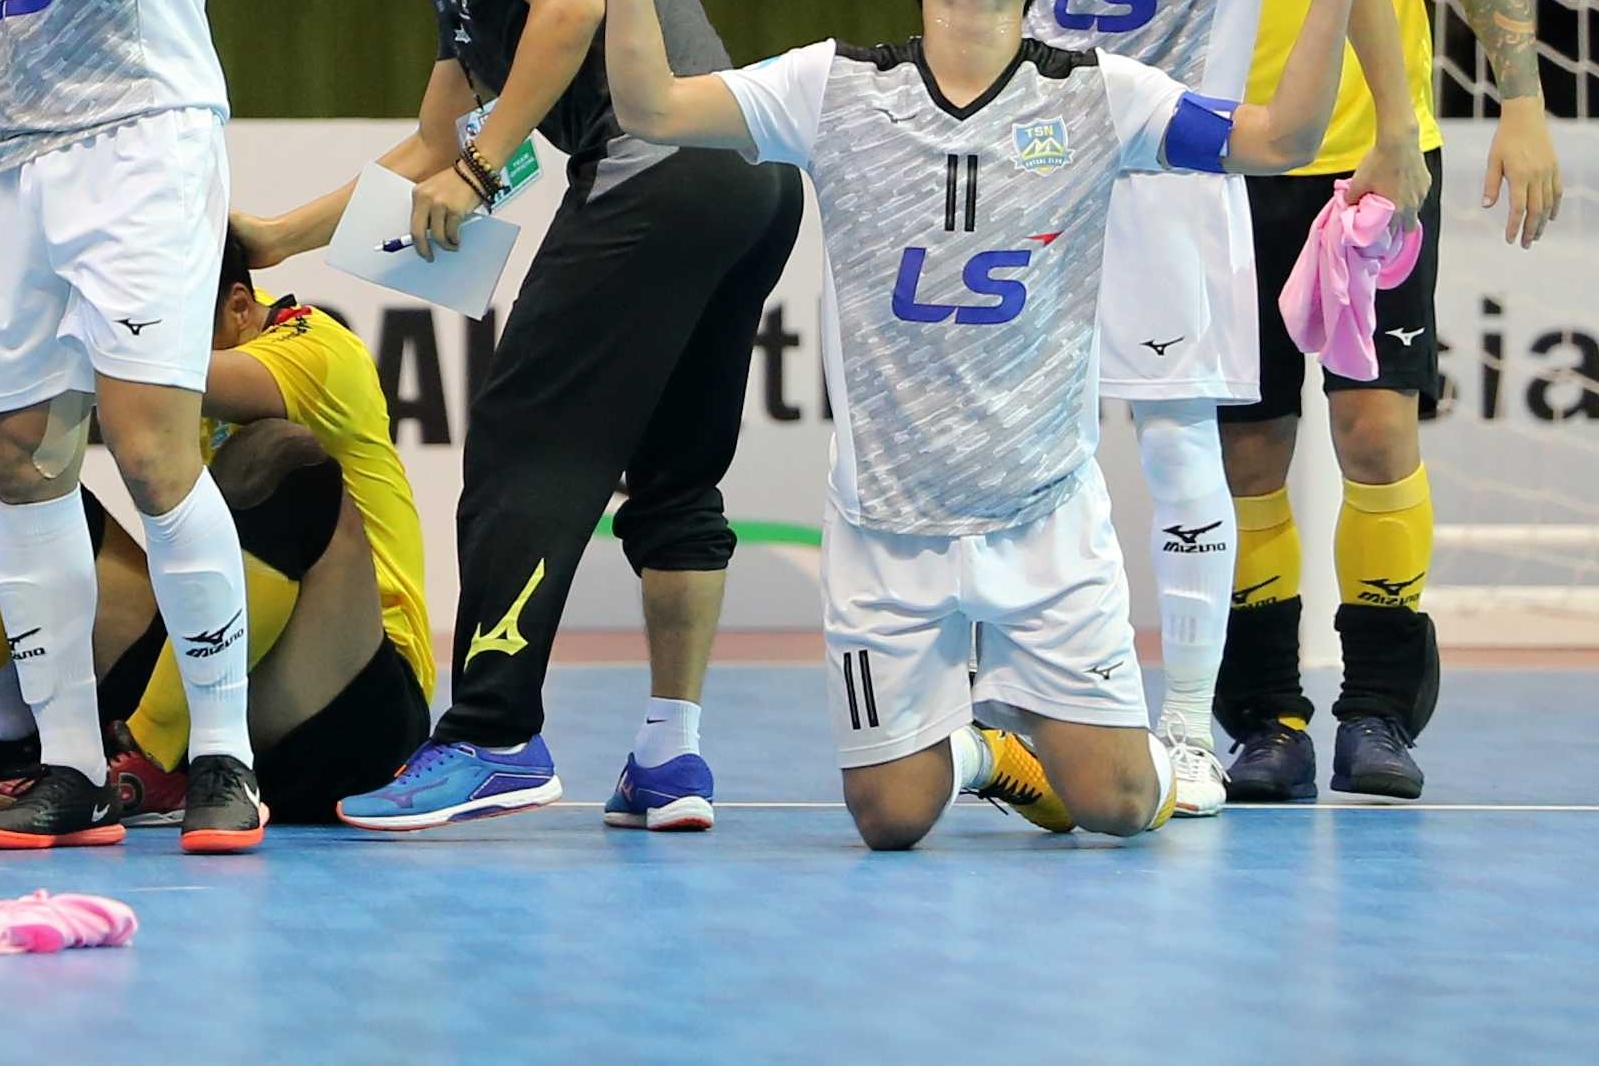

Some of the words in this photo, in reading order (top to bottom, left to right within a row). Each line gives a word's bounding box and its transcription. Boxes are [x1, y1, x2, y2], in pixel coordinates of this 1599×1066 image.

[1025, 126, 1054, 138] TSN
[945, 154, 978, 232] 11
[891, 247, 1032, 325] LS
[843, 649, 879, 730] 11
